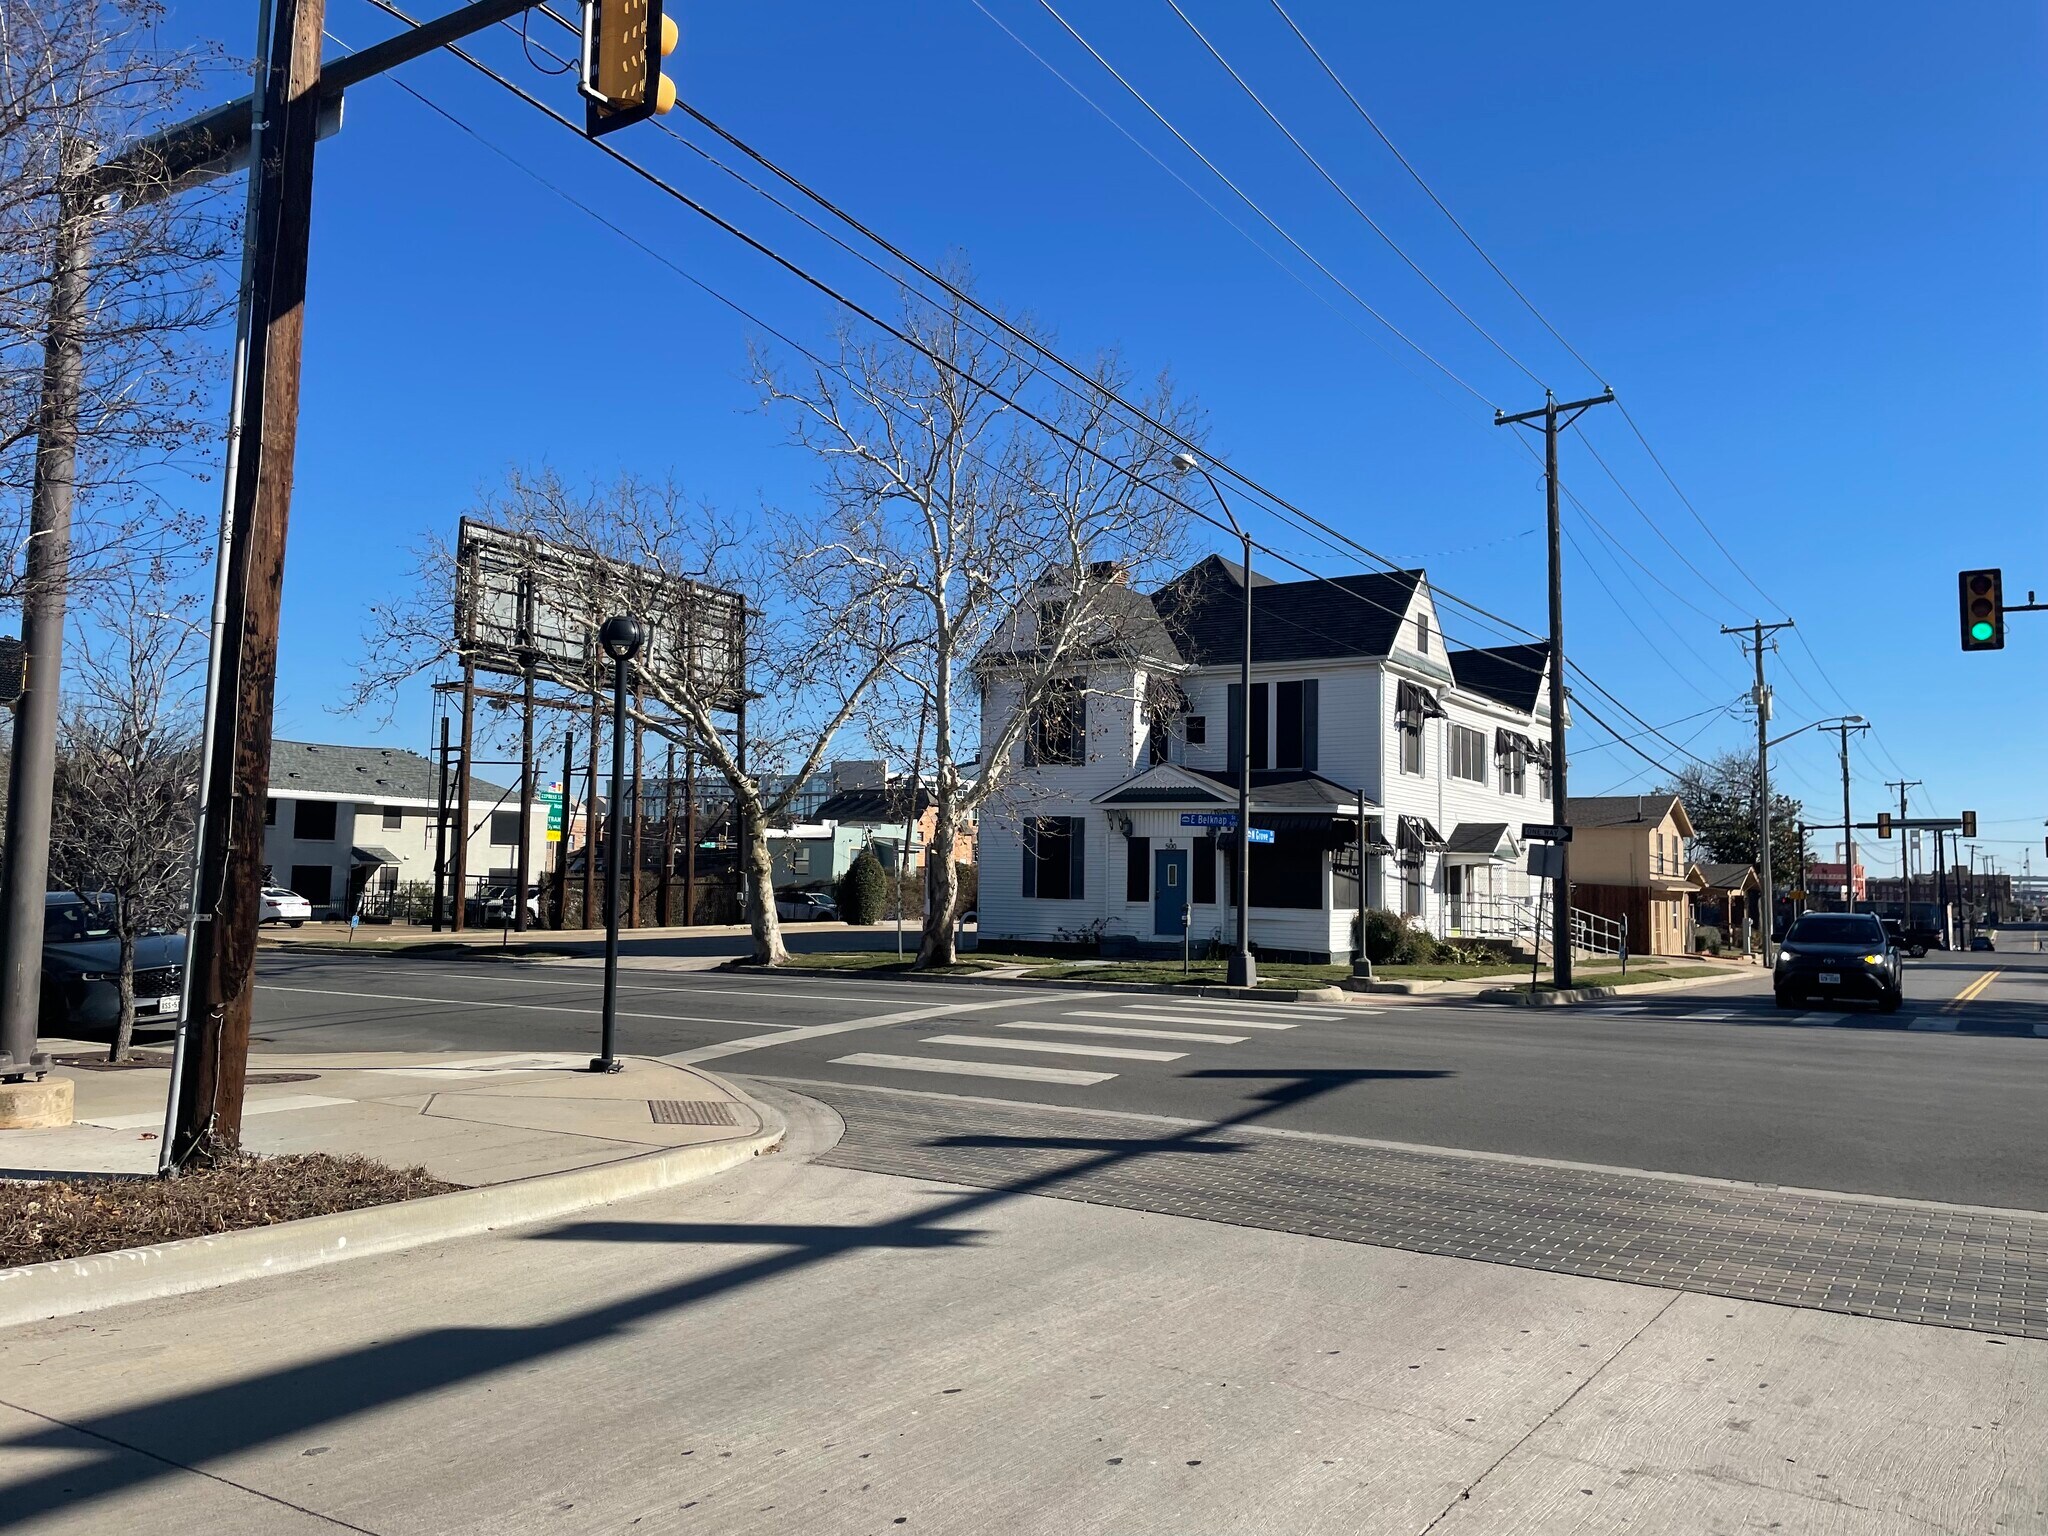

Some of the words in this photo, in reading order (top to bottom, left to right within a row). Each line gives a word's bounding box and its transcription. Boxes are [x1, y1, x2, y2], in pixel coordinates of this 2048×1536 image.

[1190, 815, 1196, 824] E
[1197, 814, 1228, 827] Belknap
[1255, 830, 1269, 841] Grove
